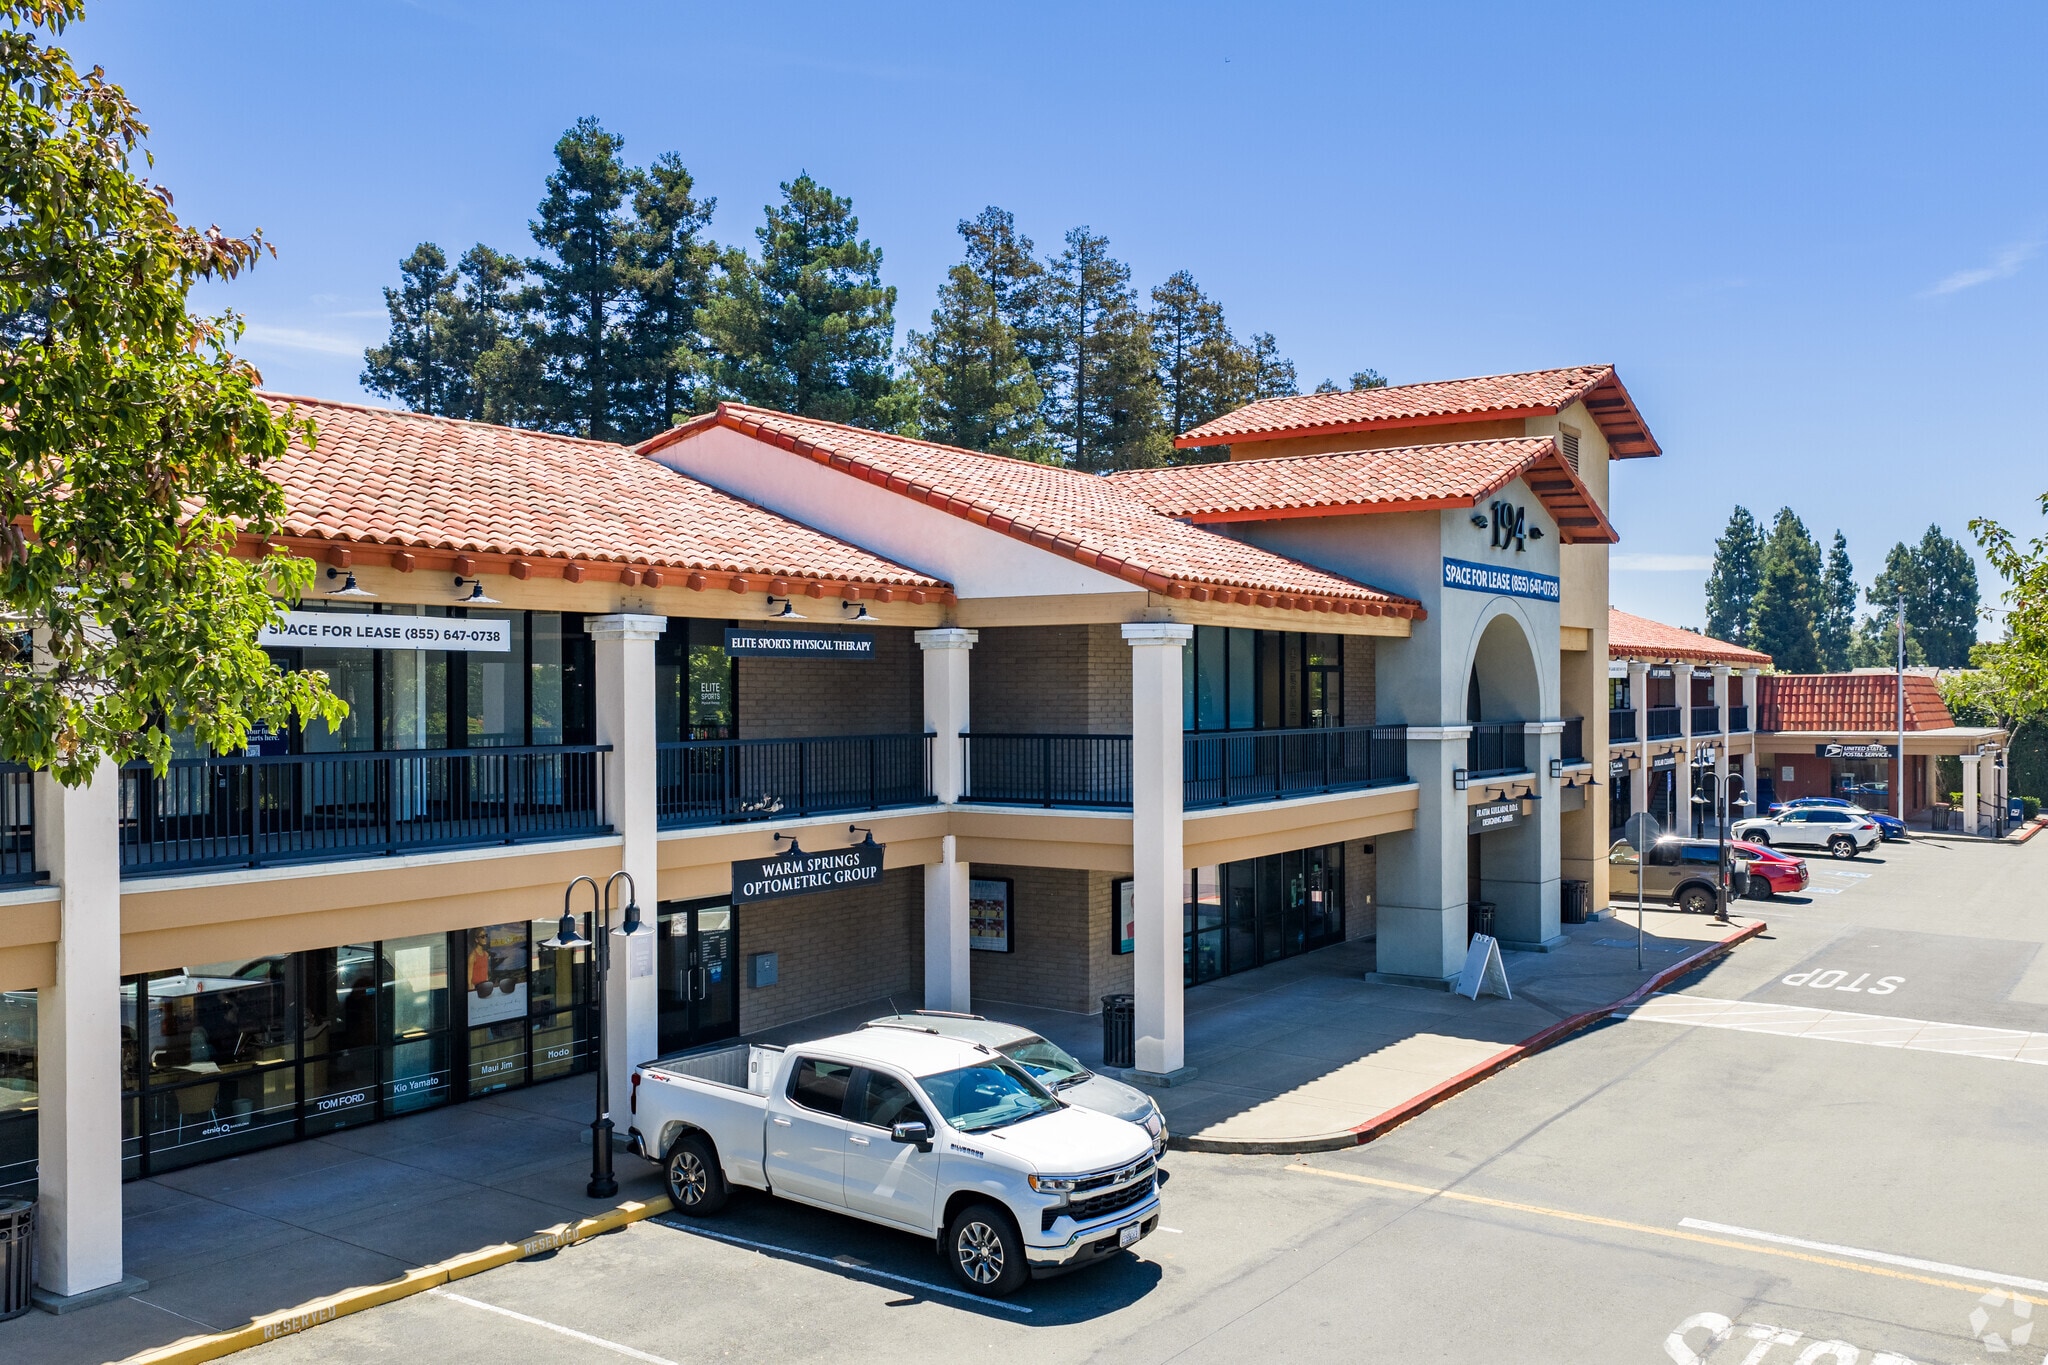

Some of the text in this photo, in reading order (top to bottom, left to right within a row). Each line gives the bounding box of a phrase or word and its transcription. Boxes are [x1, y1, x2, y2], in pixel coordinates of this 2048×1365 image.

[1490, 500, 1527, 553] 194
[1445, 564, 1559, 598] SPACE FOR LEASE (855) 647-0738
[268, 623, 501, 642] SPACE FOR LEASE (855) 647-0738
[731, 637, 872, 651] ELITE SPORTS PHYSICAL THERAPY
[701, 682, 720, 692] ELITE
[701, 692, 720, 700] SPORTS
[762, 852, 861, 878] WARM SPRINGS
[743, 865, 878, 896] OPTOMETRIC GROUP
[1781, 968, 1906, 995] STOP
[547, 1048, 570, 1059] Modo
[481, 1061, 513, 1075] Maui Jim
[393, 1076, 439, 1094] Kio Yamato
[317, 1092, 365, 1111] TOM FORD
[524, 1228, 579, 1256] RESERVED
[263, 1304, 337, 1339] RESERVED
